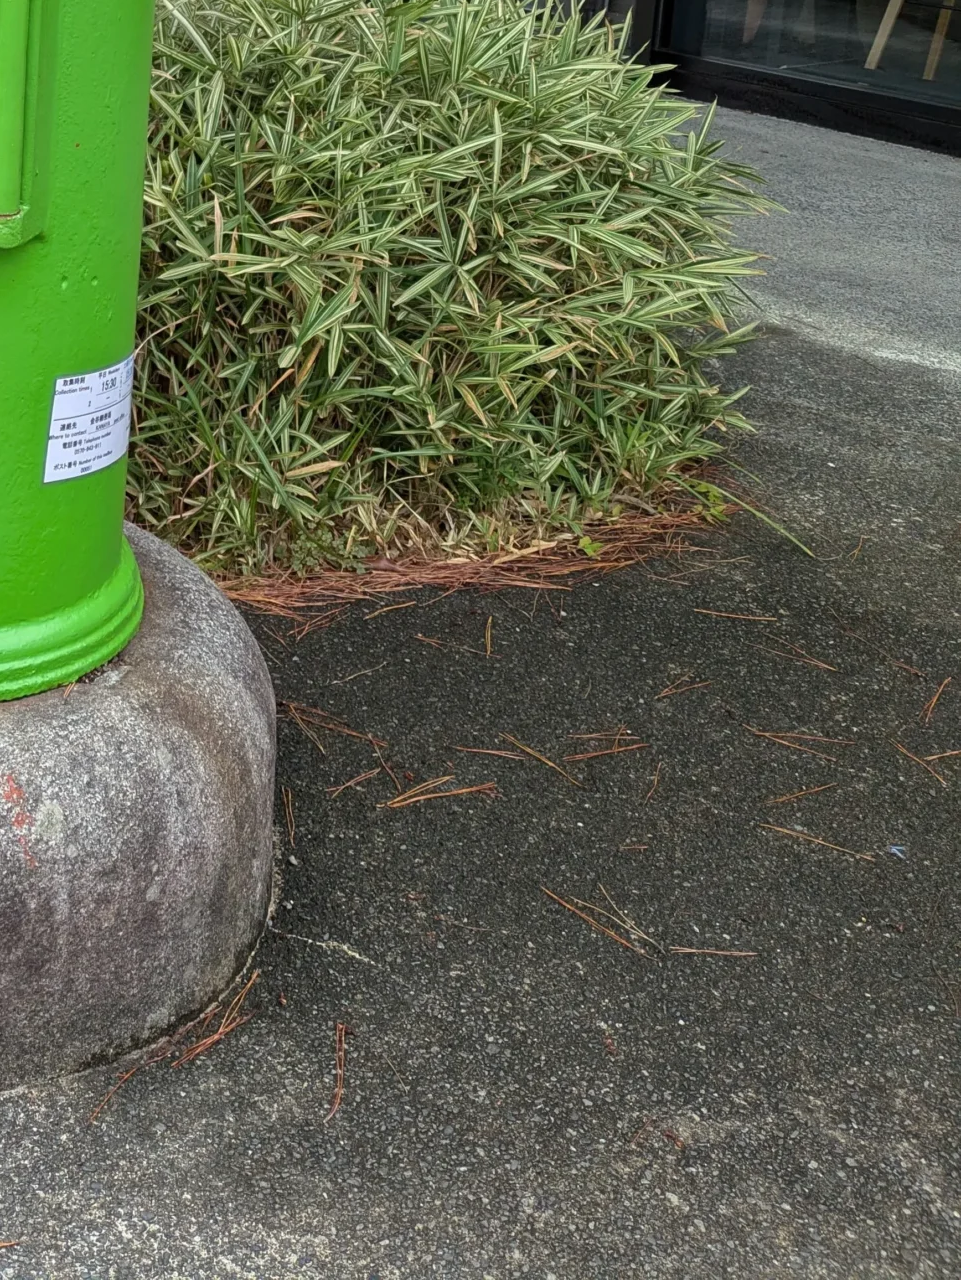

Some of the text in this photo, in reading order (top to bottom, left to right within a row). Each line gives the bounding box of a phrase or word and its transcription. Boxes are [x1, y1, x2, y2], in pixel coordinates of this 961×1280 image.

[101, 377, 117, 392] 15:30
[55, 387, 78, 396] Collection
[70, 429, 87, 438] contact
